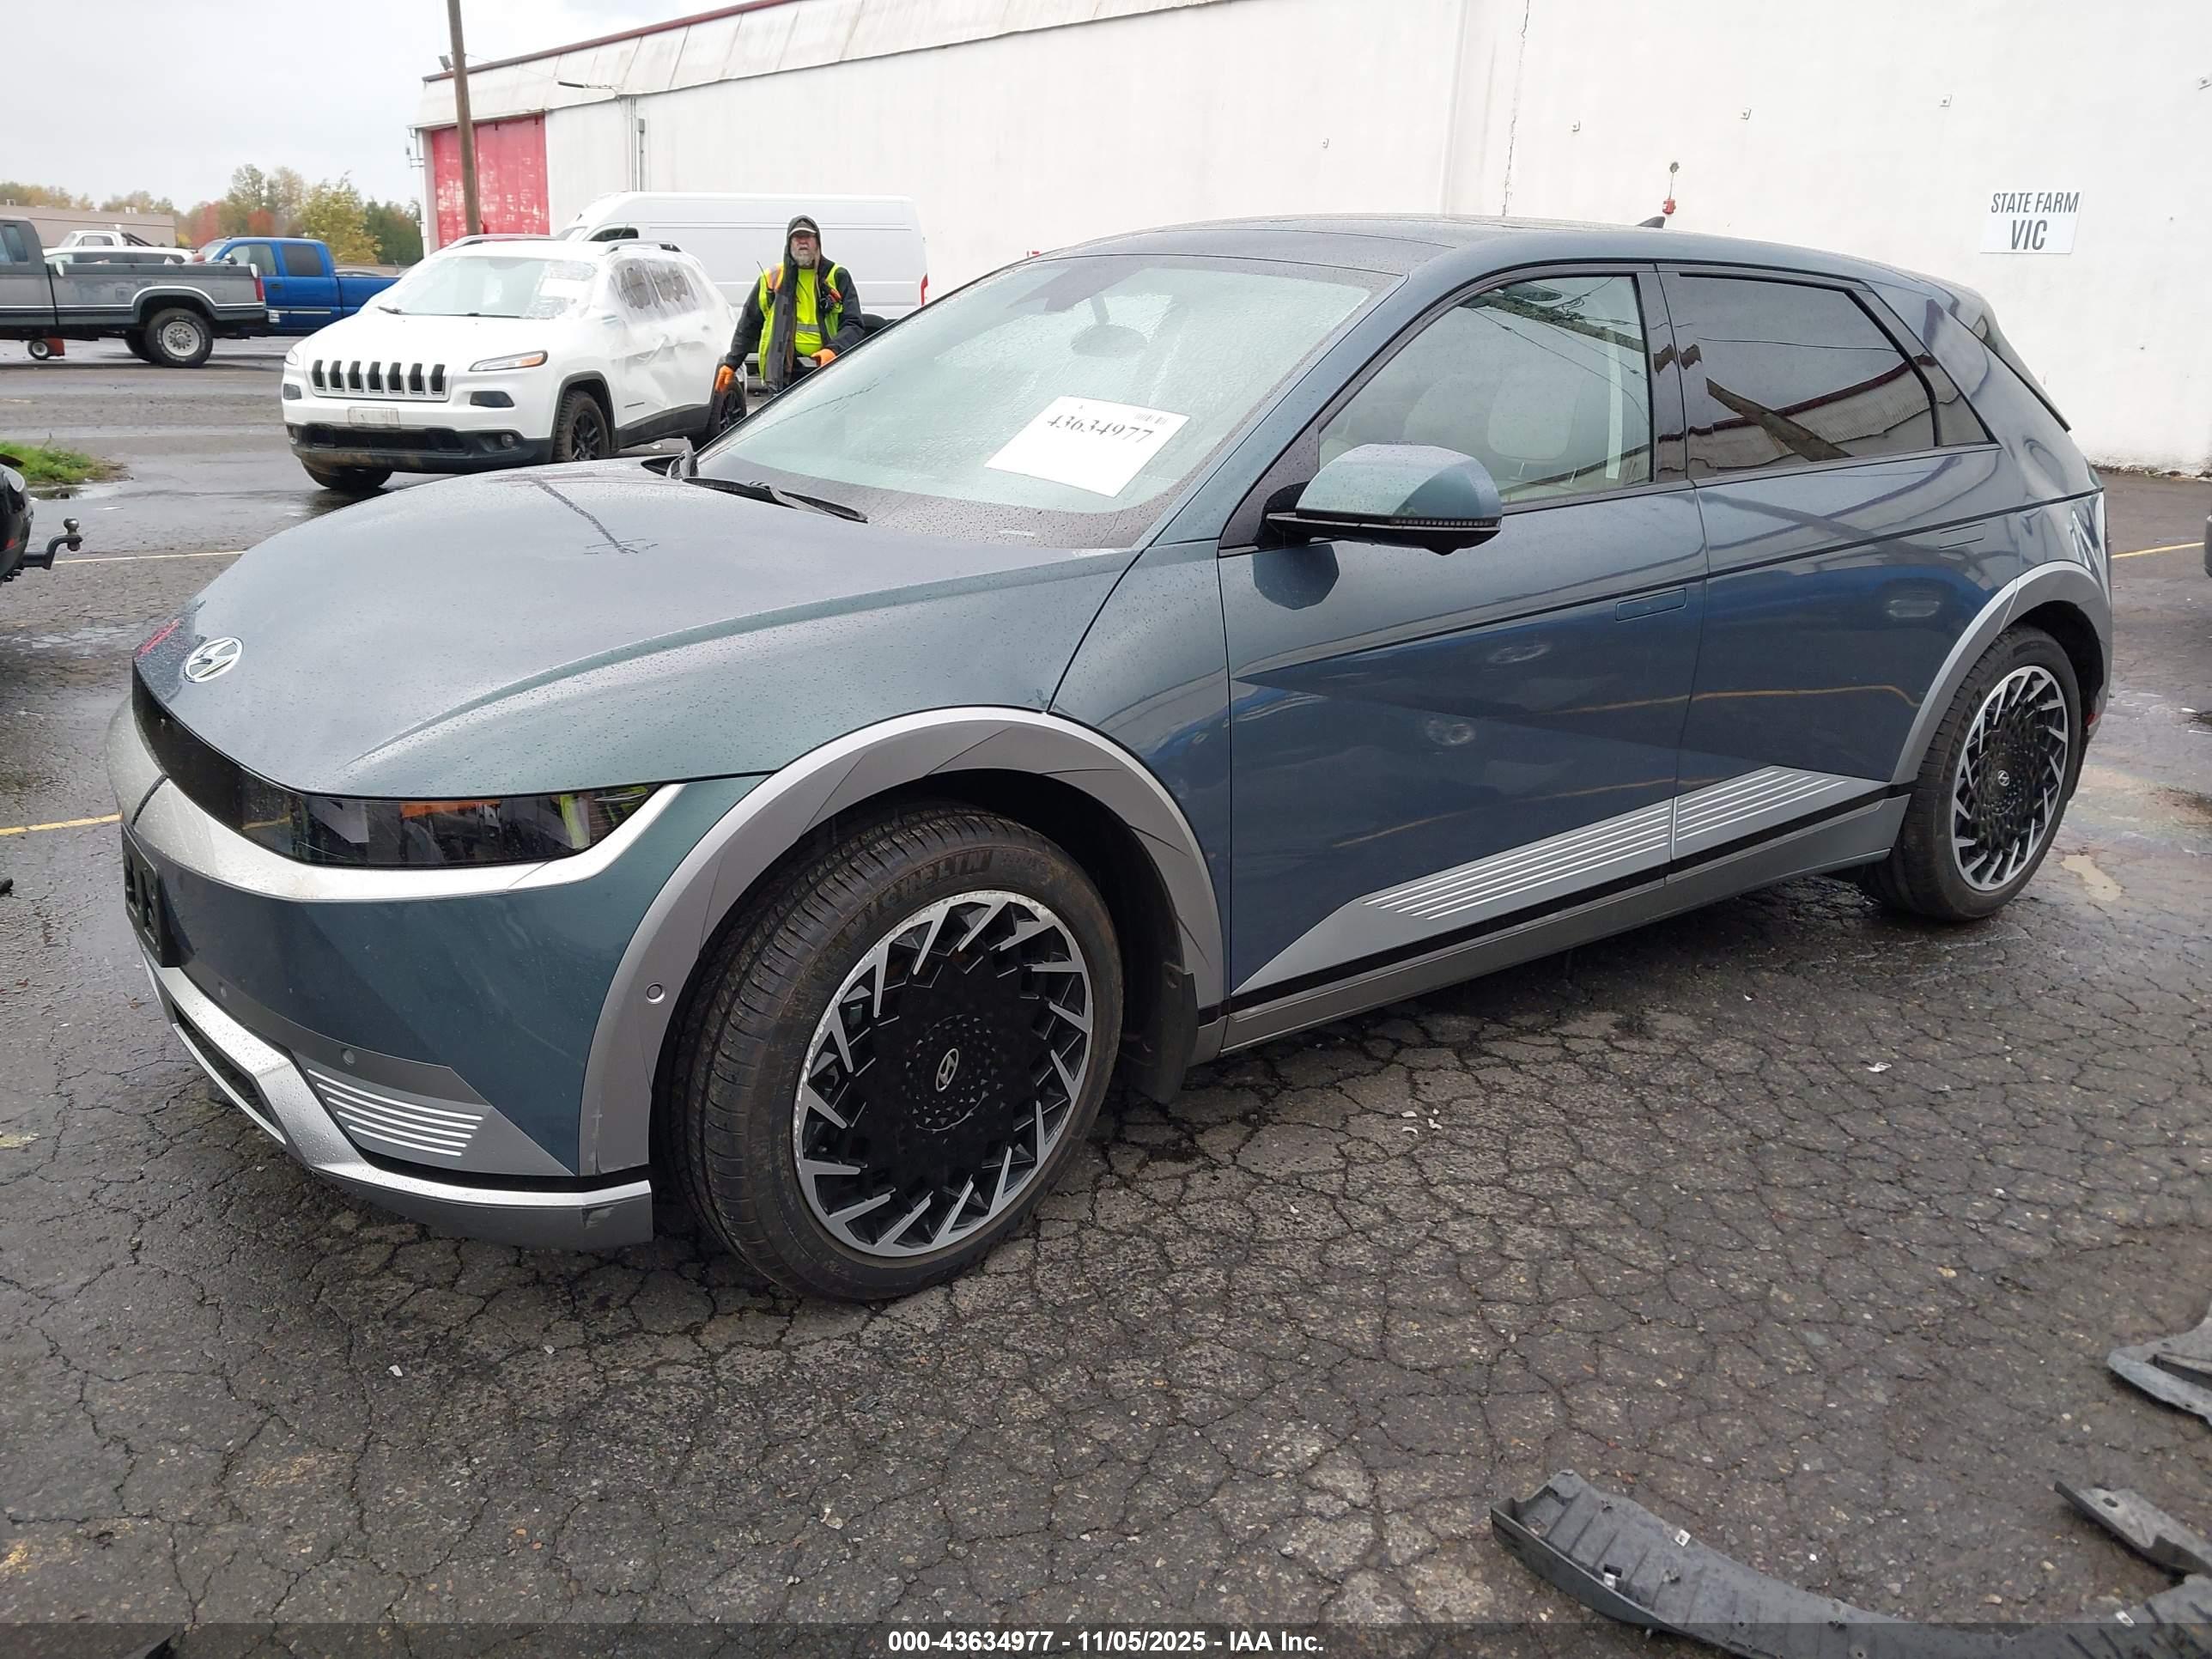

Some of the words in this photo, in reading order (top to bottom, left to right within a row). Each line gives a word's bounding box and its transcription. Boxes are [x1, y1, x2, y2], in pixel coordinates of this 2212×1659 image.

[1990, 191, 2033, 214] STATE
[2034, 191, 2081, 214] FARM
[2011, 219, 2048, 251] VIC
[1048, 415, 1154, 443] 43634977
